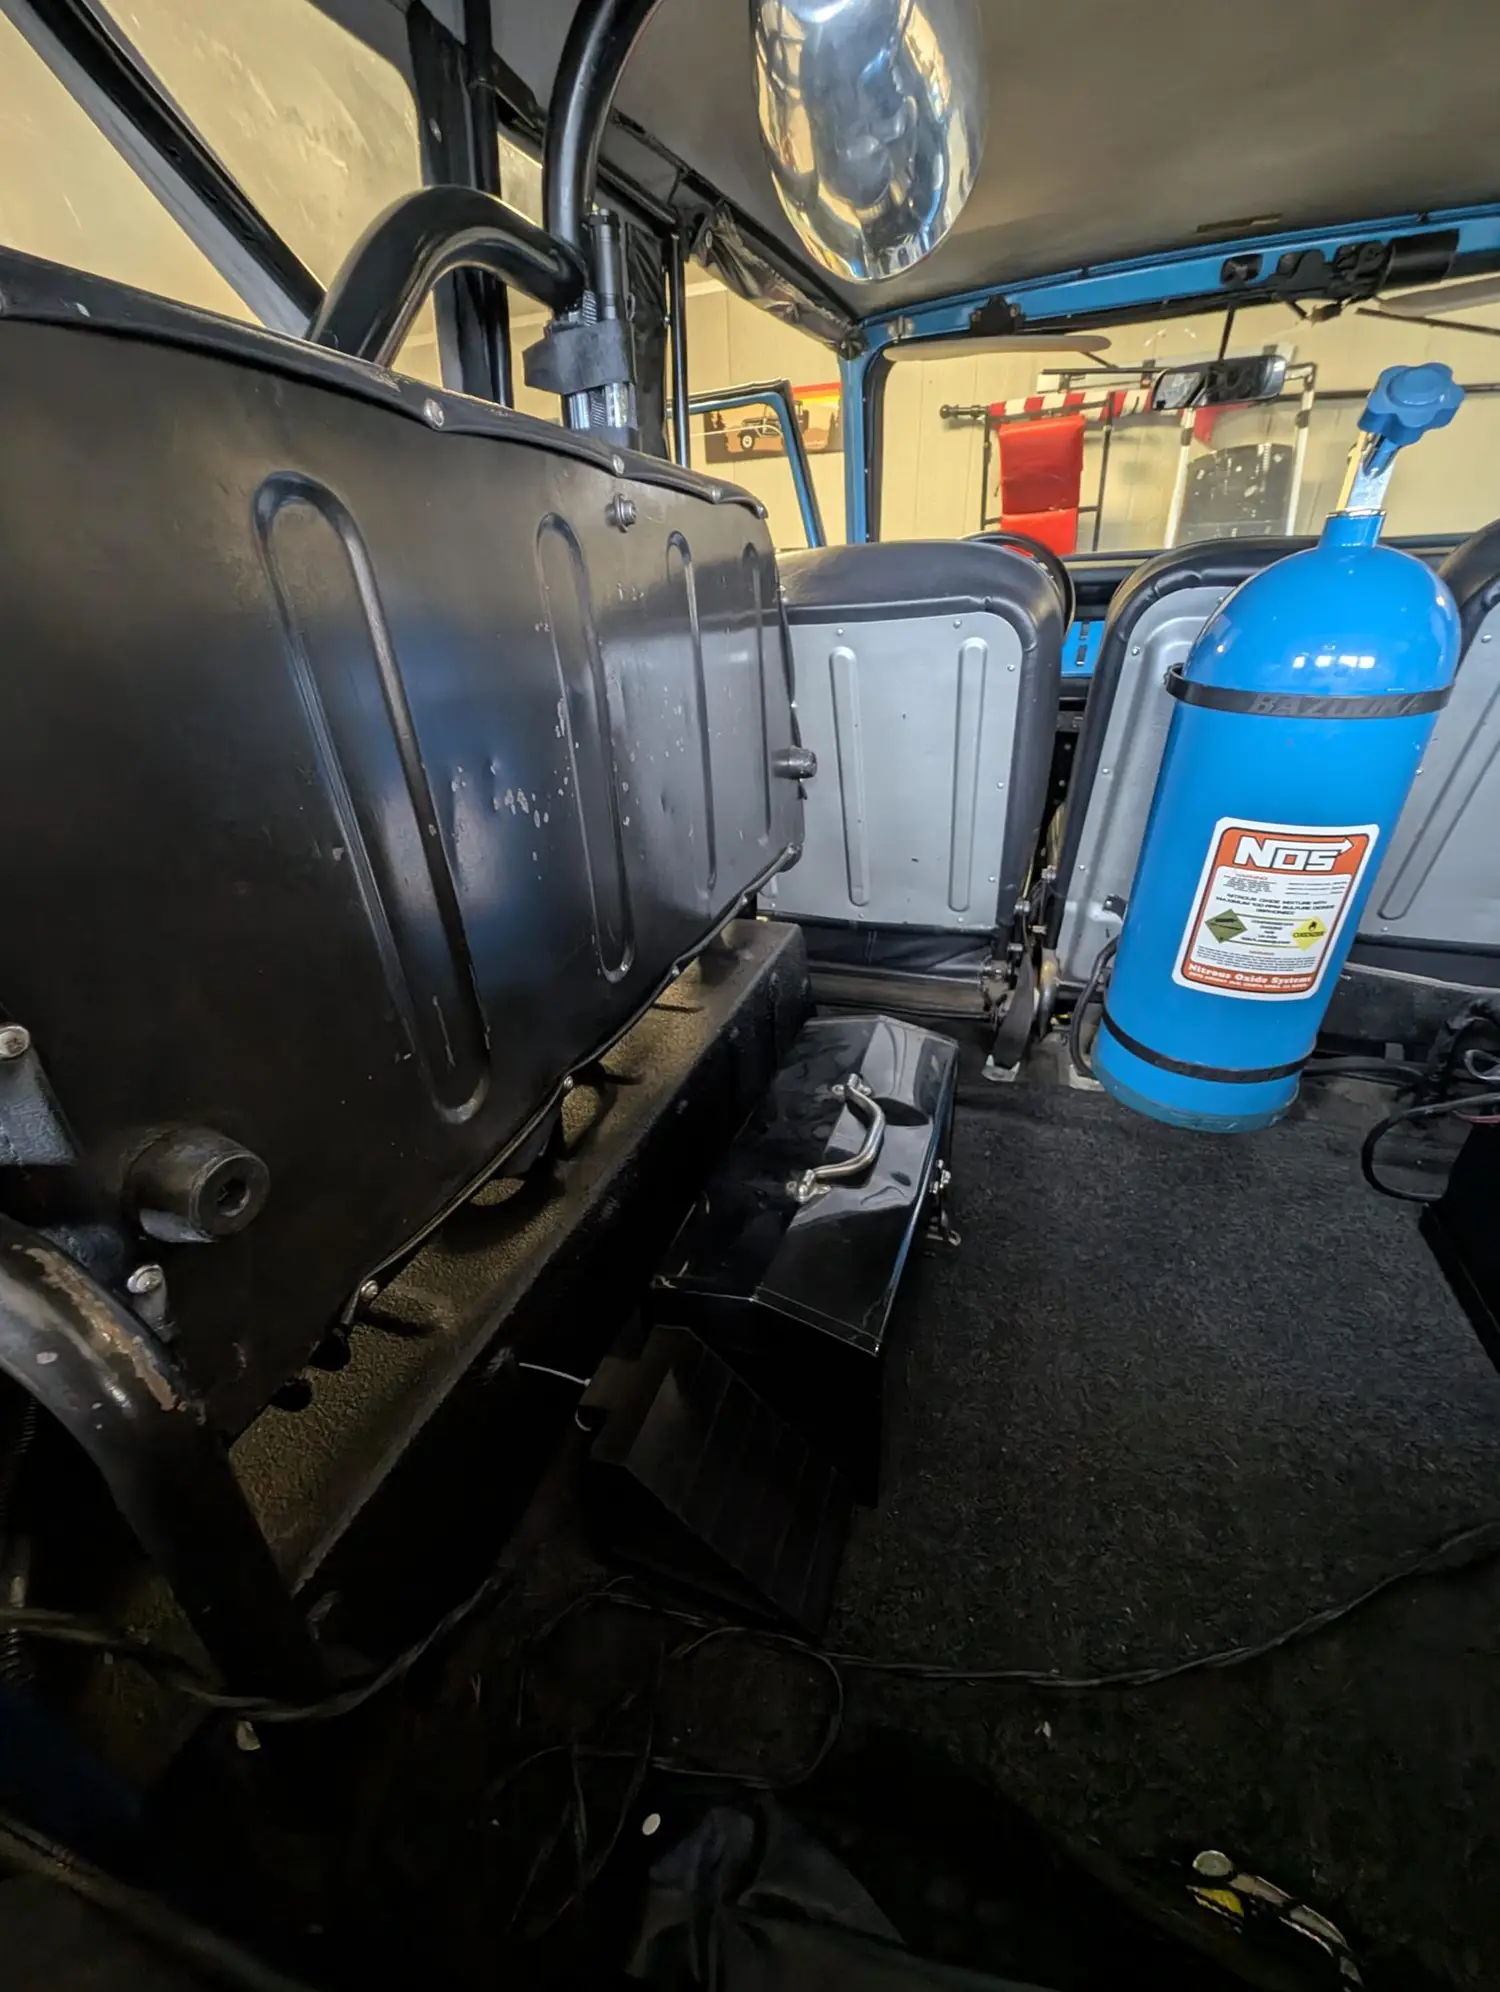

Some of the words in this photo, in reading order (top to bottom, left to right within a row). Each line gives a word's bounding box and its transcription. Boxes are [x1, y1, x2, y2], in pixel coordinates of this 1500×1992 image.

[1233, 834, 1354, 872] NOS
[1188, 963, 1232, 979] Nitrous
[1234, 973, 1270, 984] Oxide
[1270, 975, 1313, 986] Systems
